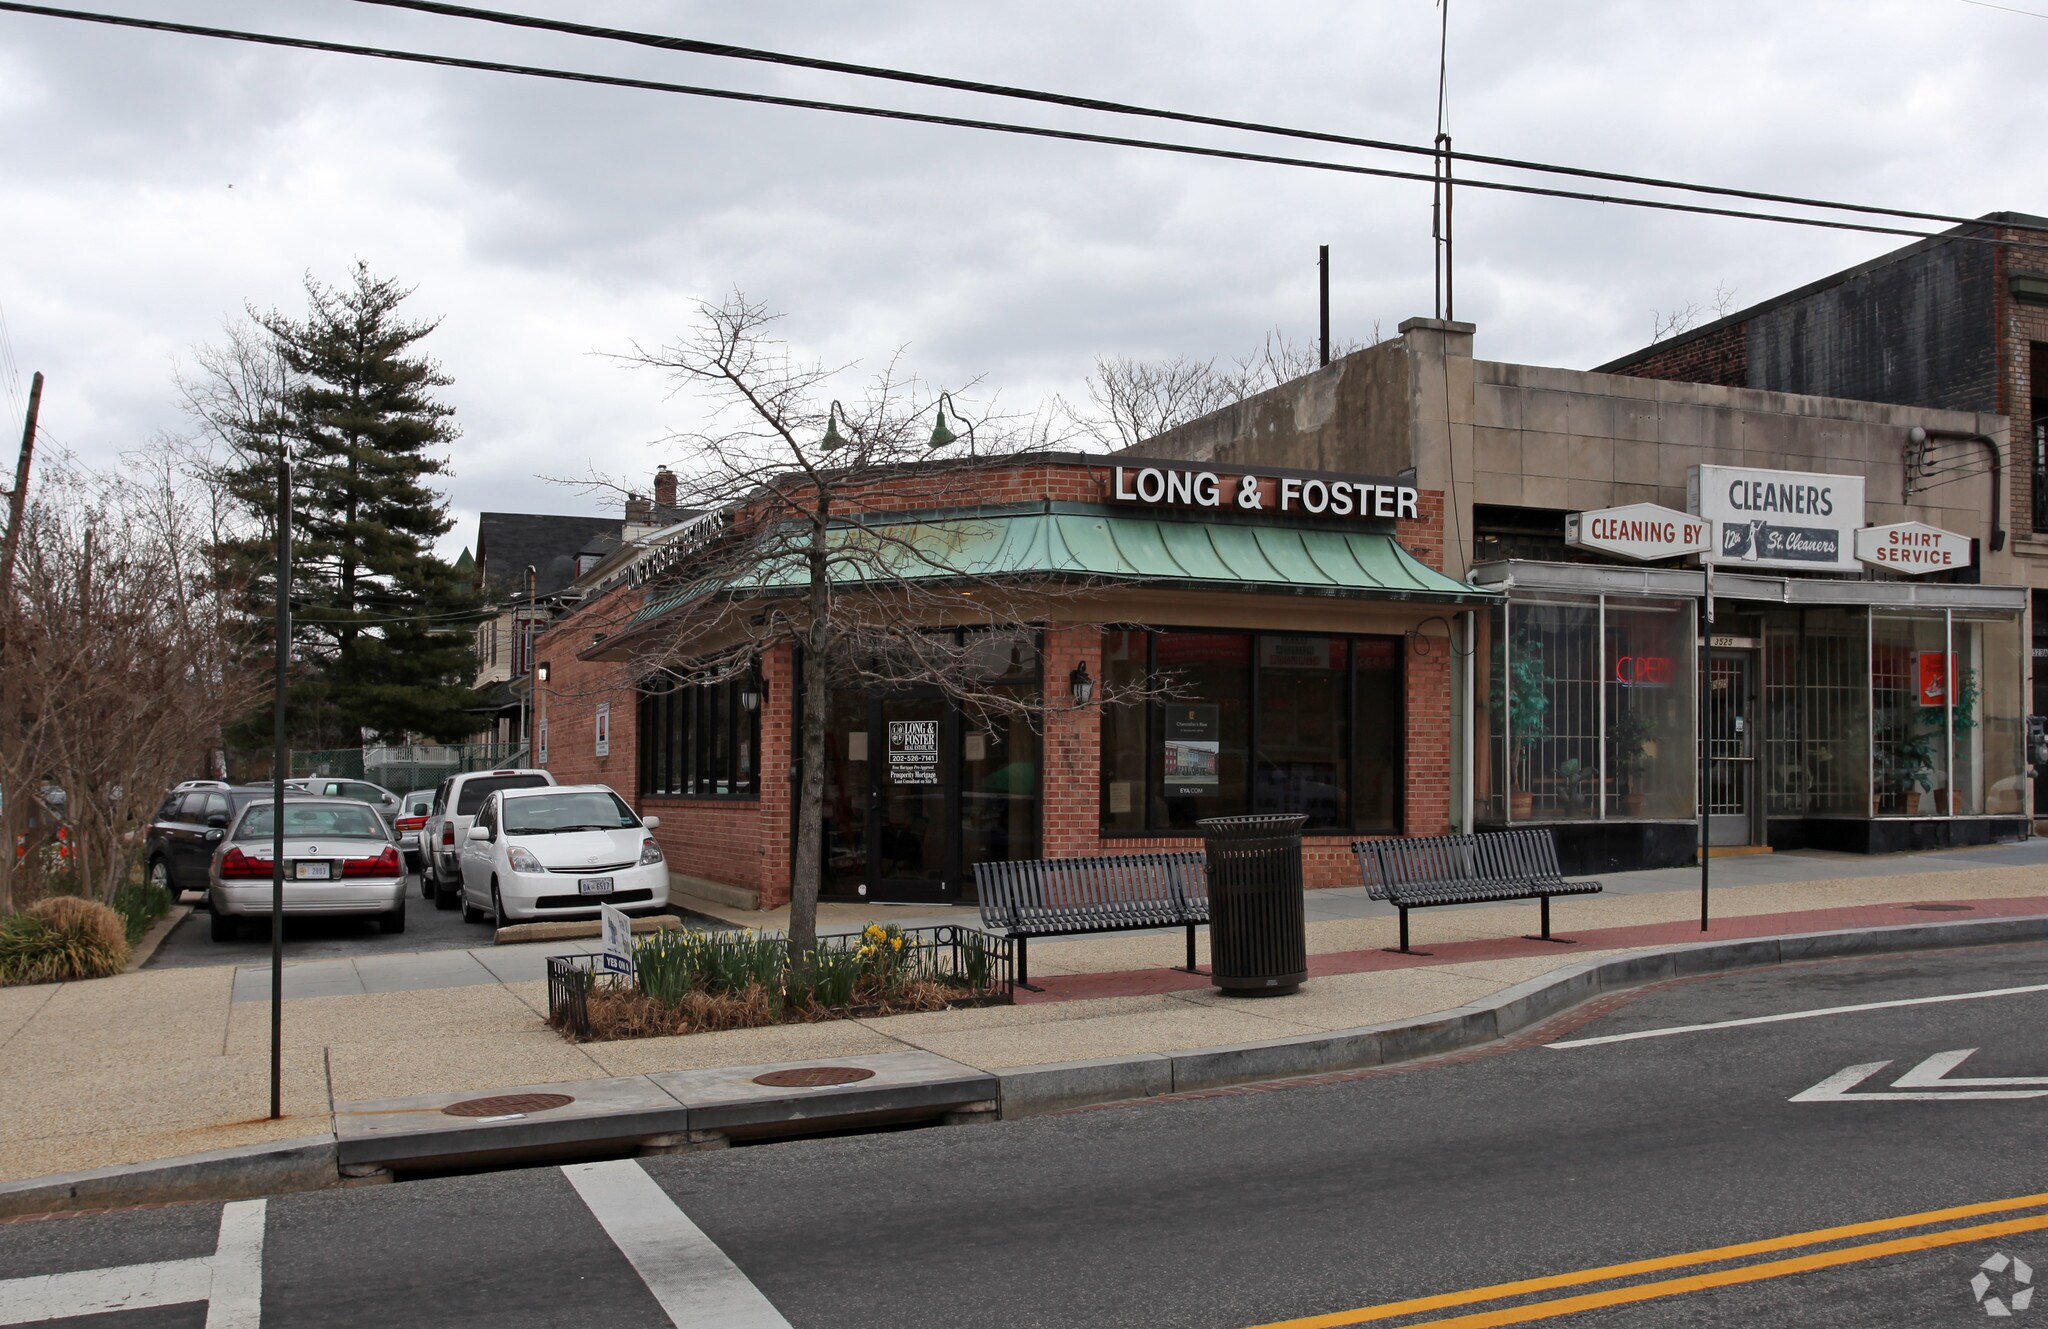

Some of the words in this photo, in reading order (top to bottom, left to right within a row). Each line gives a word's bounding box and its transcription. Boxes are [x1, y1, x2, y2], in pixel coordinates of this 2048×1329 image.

[1116, 466, 1221, 507] LONG
[1237, 475, 1263, 510] &
[1281, 478, 1419, 519] FOSTER
[1729, 480, 1833, 516] CLEANERS
[1591, 518, 1676, 543] CLEANING
[1684, 524, 1703, 545] BY
[1889, 530, 1942, 547] SHIRT
[1724, 529, 1741, 549] 12th
[1767, 531, 1784, 549] St.
[1785, 533, 1837, 553] Cleaners
[1877, 547, 1952, 565] SERVICE
[1714, 638, 1733, 646] 3525
[904, 722, 926, 733] LONG
[927, 722, 935, 734] &
[904, 734, 935, 745] FOSTER
[890, 771, 914, 779] Prosperity
[914, 771, 936, 779] Mortgage
[606, 956, 618, 968] YES
